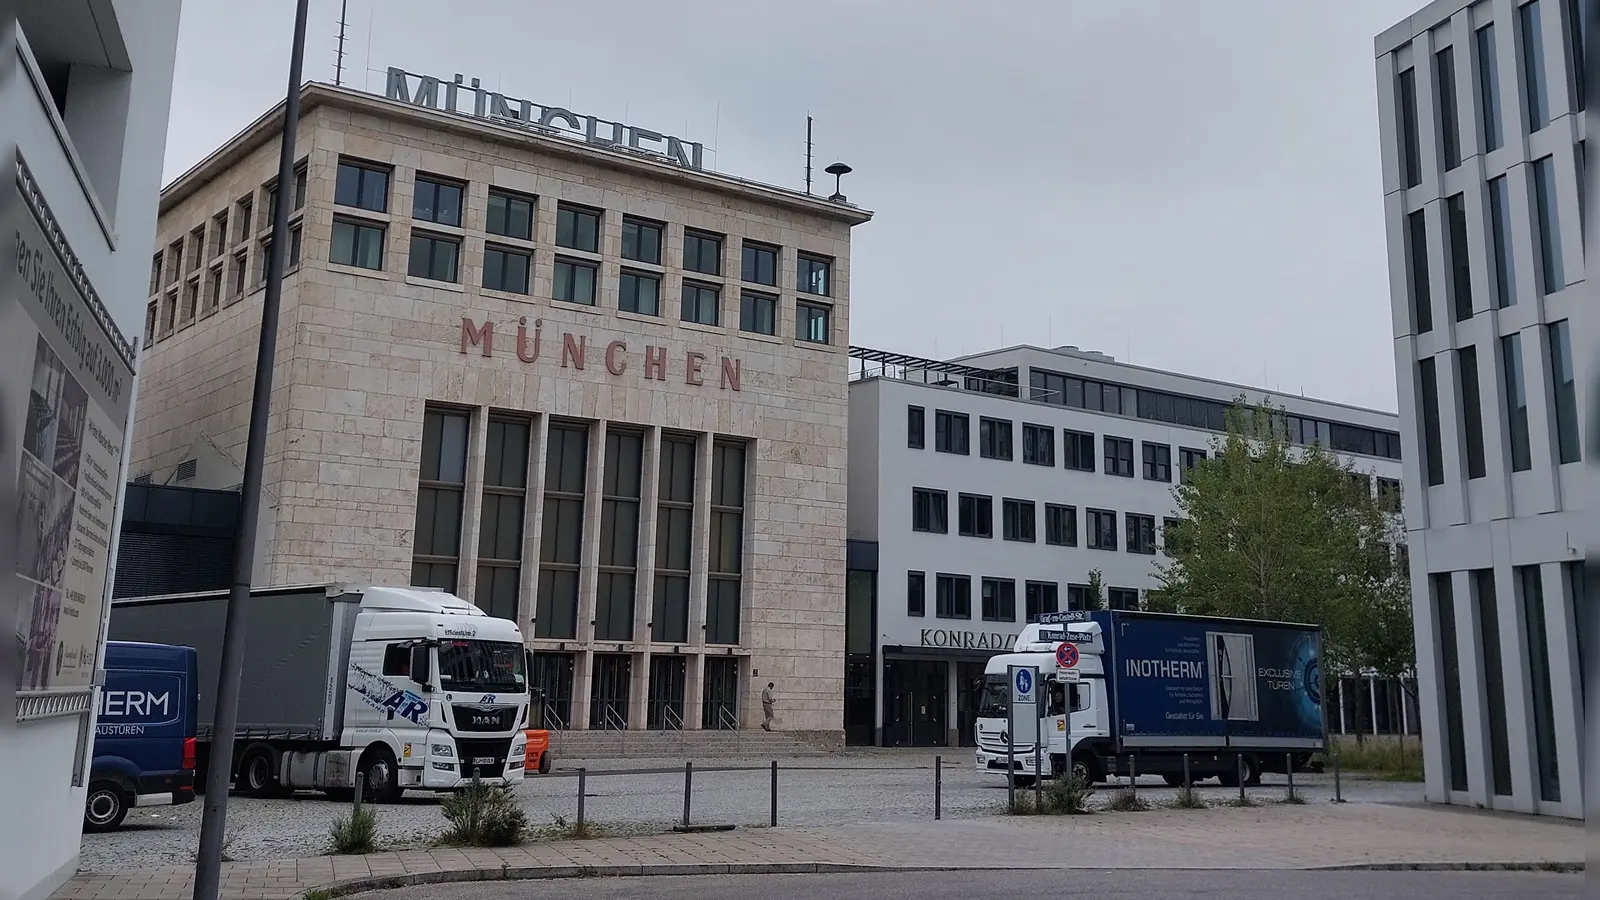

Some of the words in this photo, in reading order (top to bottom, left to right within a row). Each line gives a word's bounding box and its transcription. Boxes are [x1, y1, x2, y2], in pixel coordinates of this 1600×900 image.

[31, 249, 46, 304] Sie
[45, 270, 66, 334] Ihren
[65, 303, 87, 369] Erfolg
[86, 342, 99, 376] auf
[459, 316, 742, 391] MÜNCHEN
[1126, 659, 1203, 679] INOTHERM
[1258, 667, 1302, 679] EXCLUSIVE
[1267, 679, 1295, 690] TÜREN
[361, 696, 386, 714] TRANS
[472, 716, 500, 725] MAN
